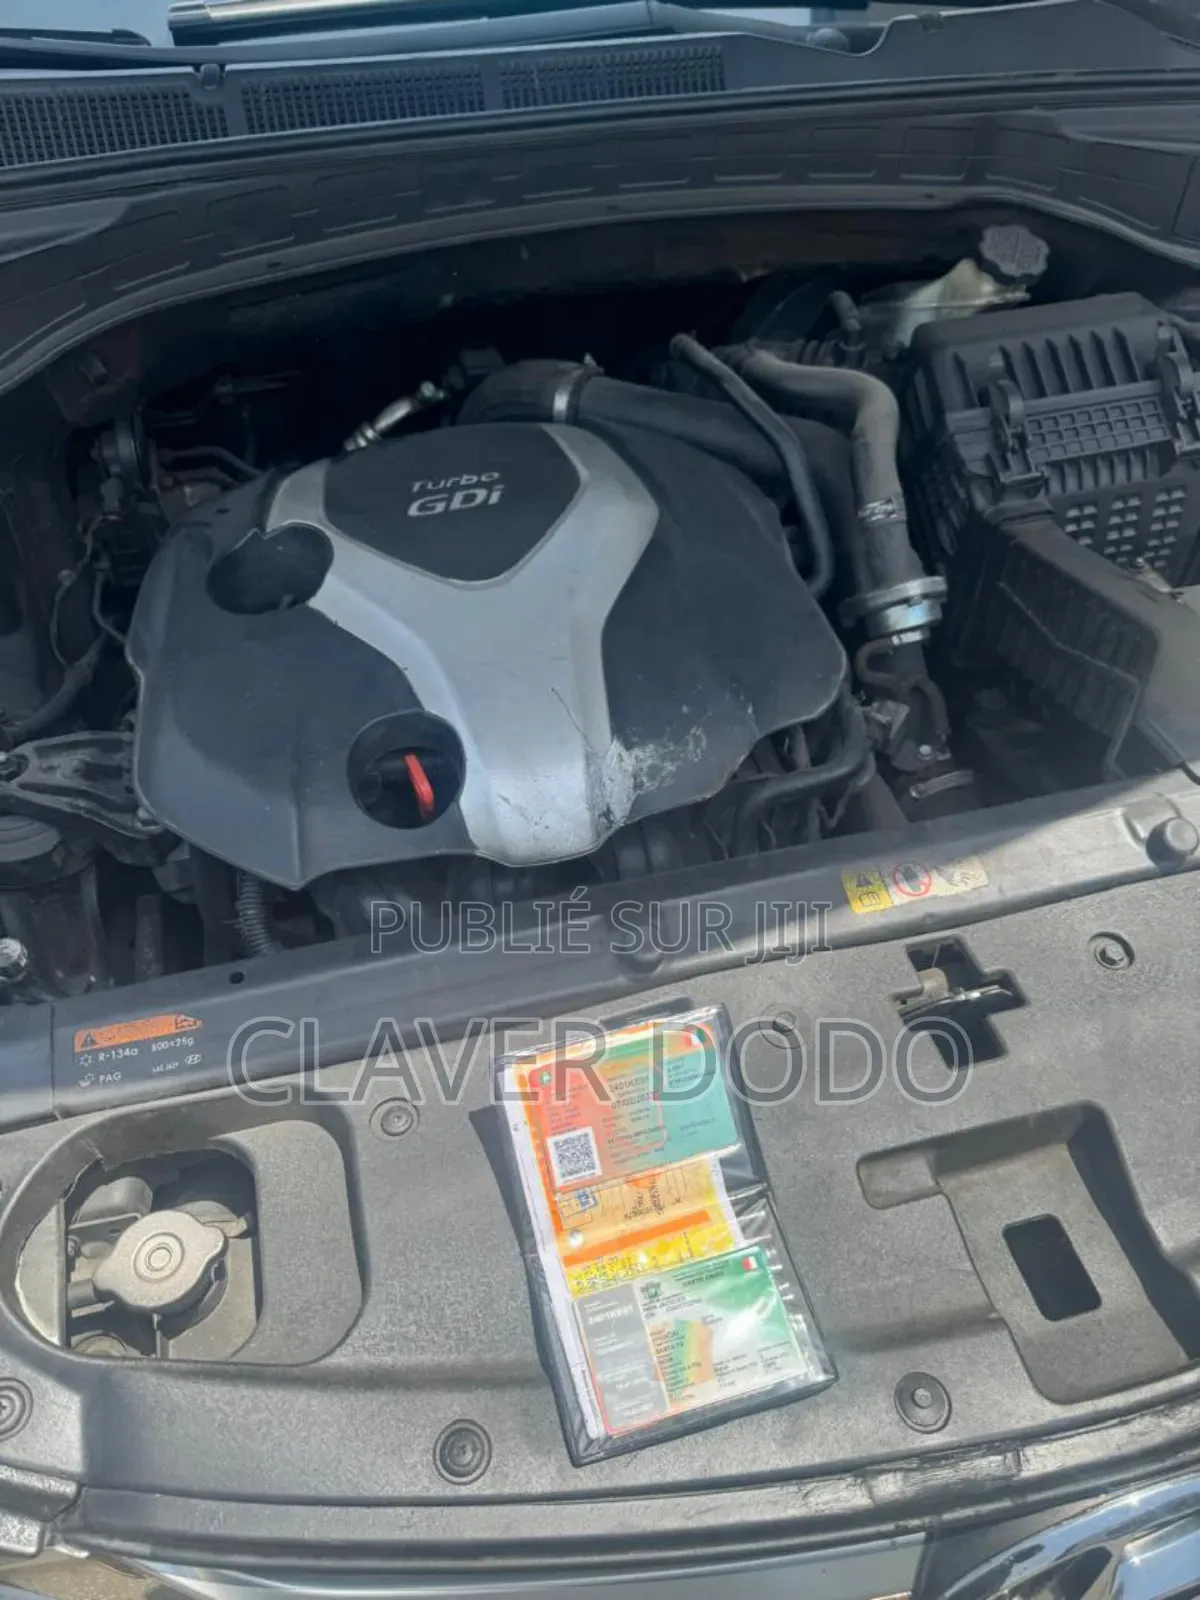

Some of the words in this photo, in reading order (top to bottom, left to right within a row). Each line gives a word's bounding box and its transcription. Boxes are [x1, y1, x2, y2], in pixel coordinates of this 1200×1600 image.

[411, 472, 501, 493] Turbo
[407, 484, 505, 517] GDi
[98, 1071, 123, 1085] PAG
